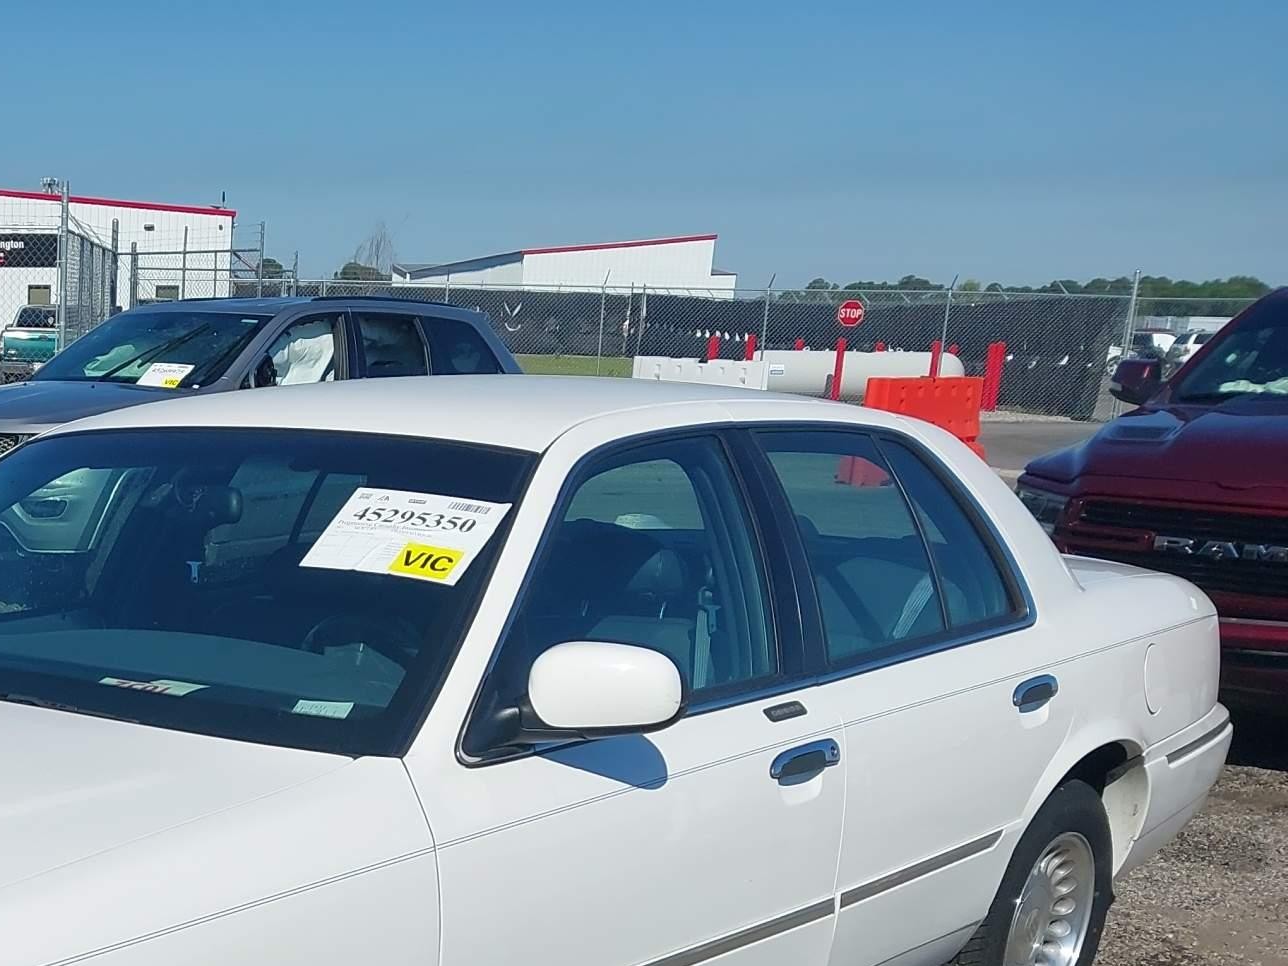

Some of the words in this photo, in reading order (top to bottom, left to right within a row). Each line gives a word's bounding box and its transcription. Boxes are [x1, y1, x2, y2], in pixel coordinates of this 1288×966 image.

[839, 308, 862, 319] STOP
[352, 506, 477, 533] 45295350
[1153, 536, 1288, 561] RAM
[403, 550, 454, 572] VIC
